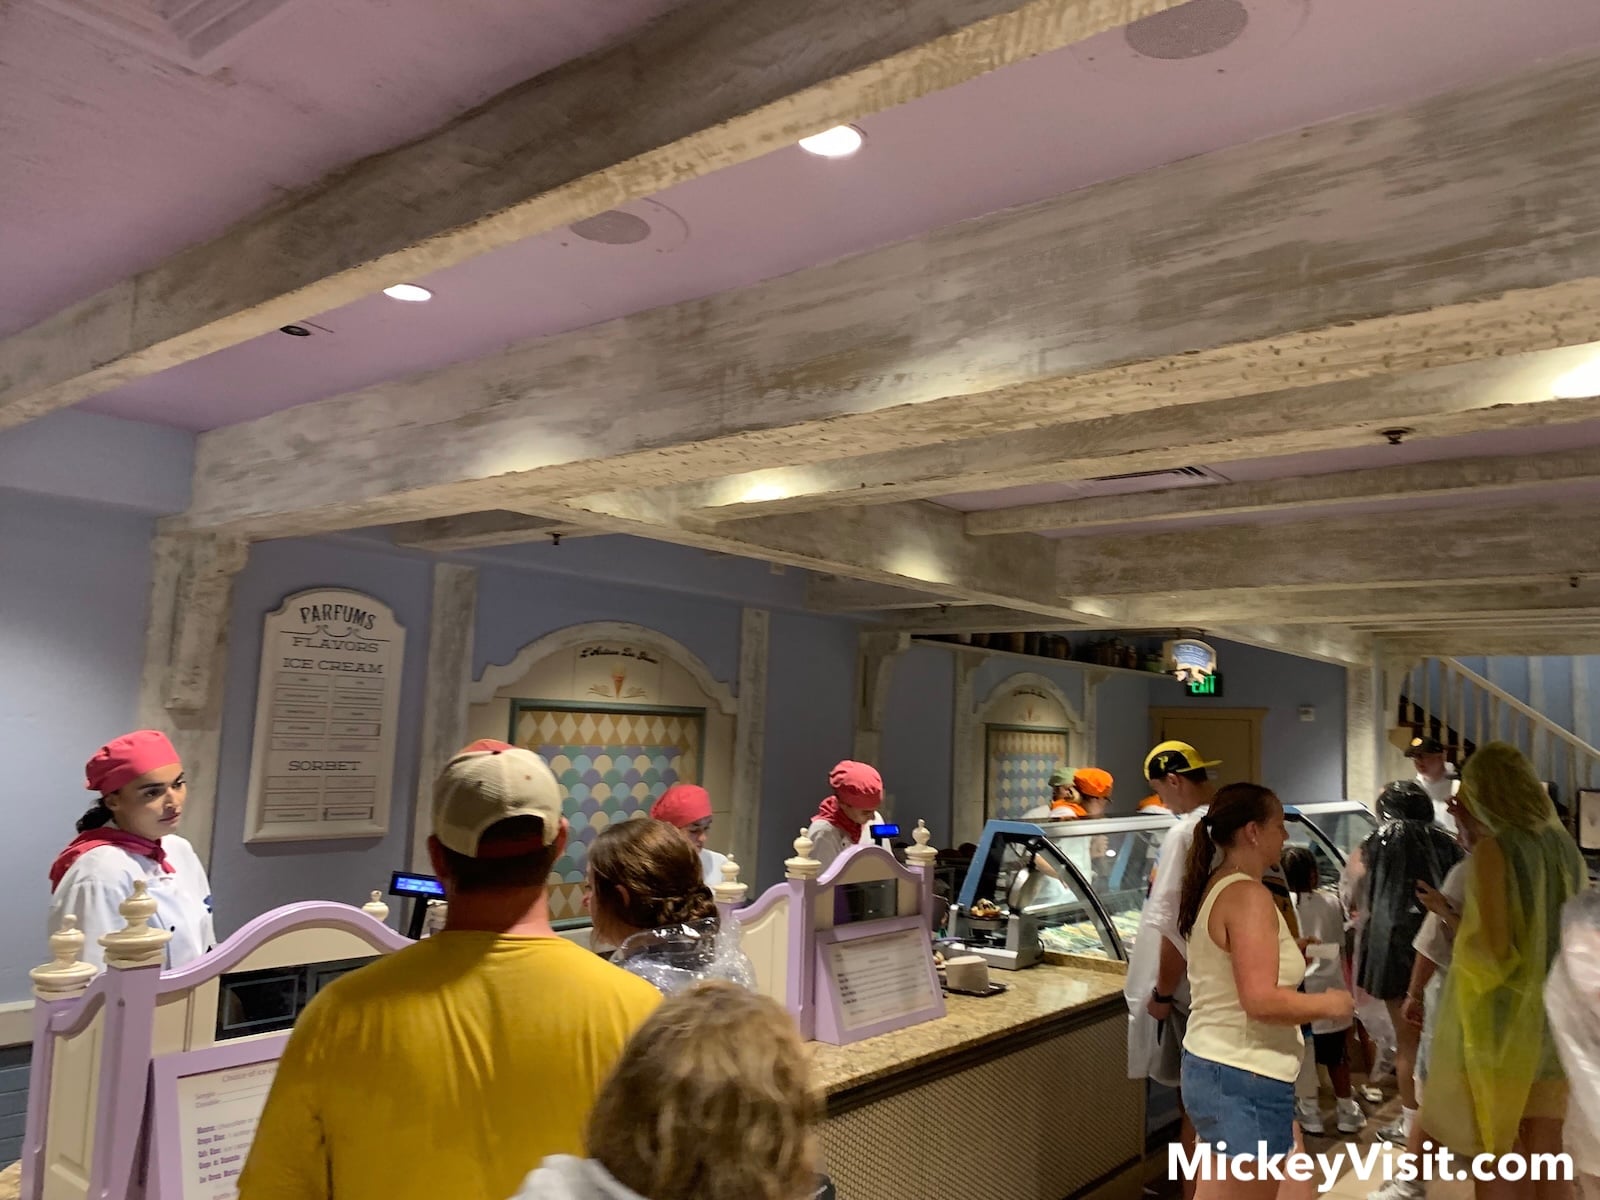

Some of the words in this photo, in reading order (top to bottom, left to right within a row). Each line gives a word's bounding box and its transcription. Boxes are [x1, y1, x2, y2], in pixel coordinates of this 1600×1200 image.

[300, 604, 376, 630] PARFUMS
[292, 637, 379, 653] FLAVORS
[282, 657, 313, 669] ICE
[317, 660, 384, 673] CREAM
[288, 760, 362, 771] SORBET
